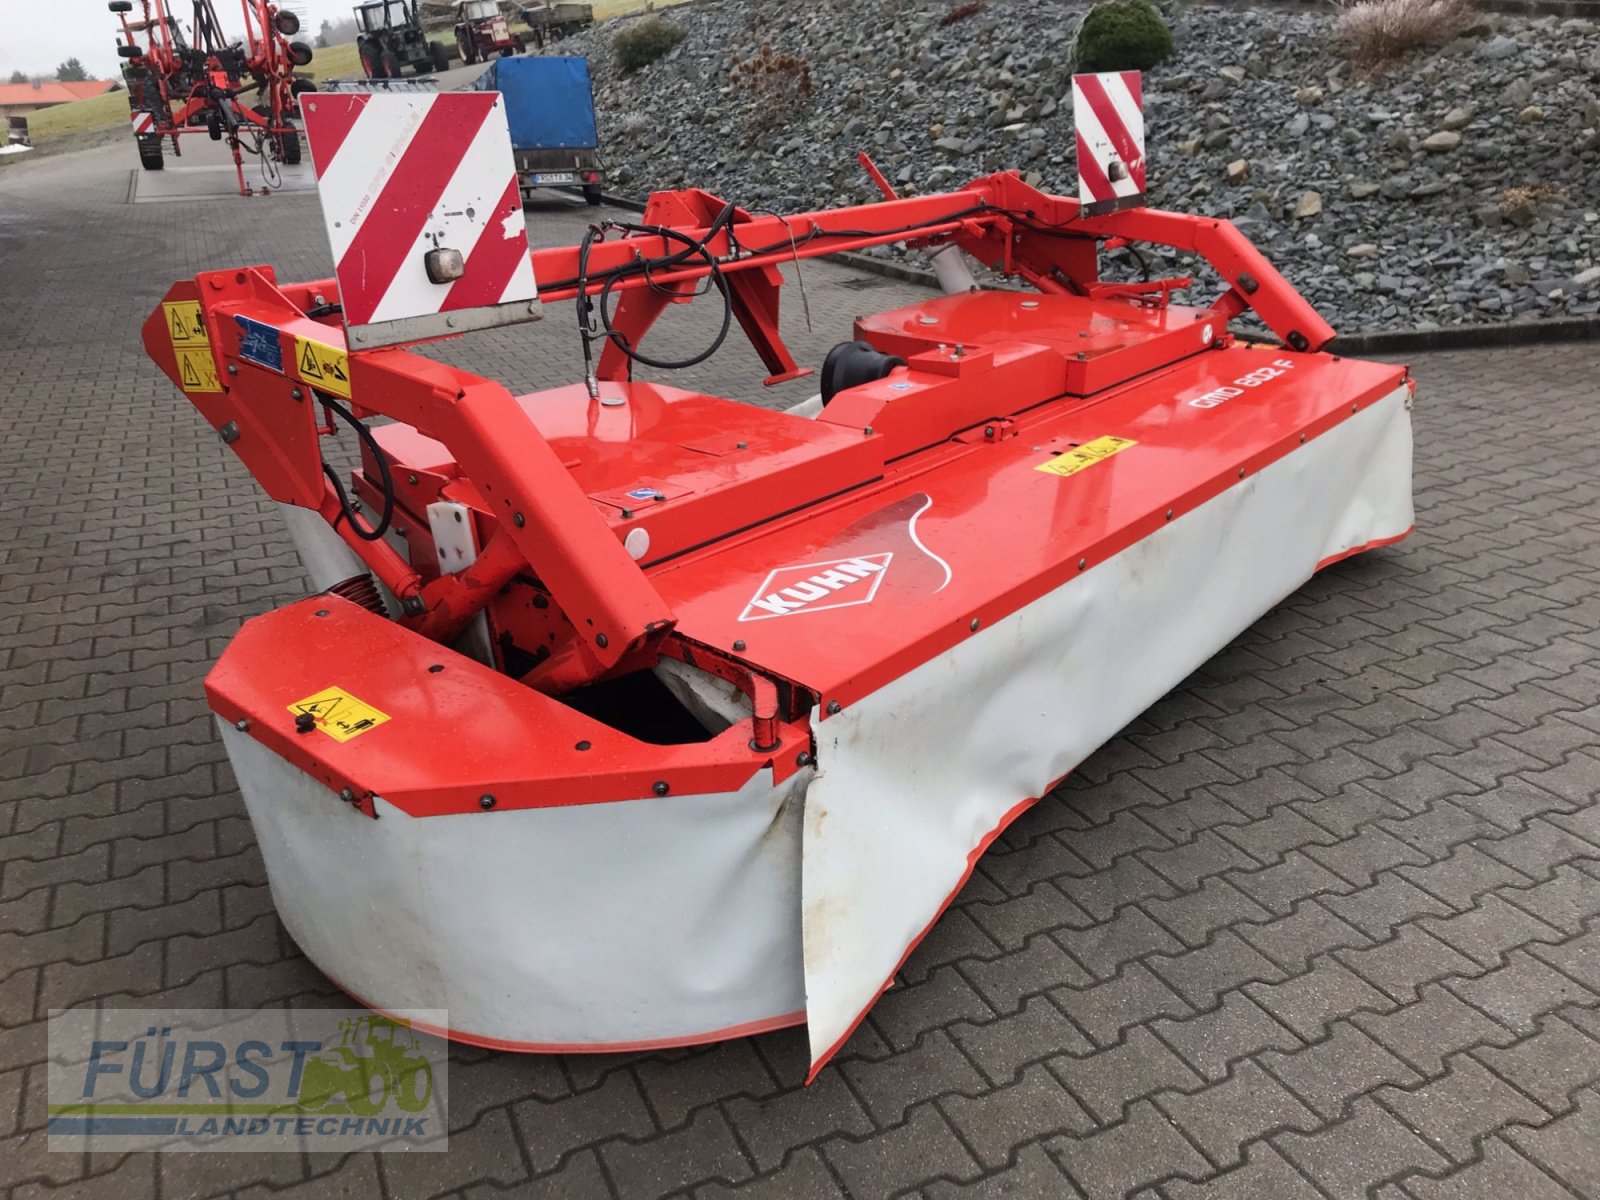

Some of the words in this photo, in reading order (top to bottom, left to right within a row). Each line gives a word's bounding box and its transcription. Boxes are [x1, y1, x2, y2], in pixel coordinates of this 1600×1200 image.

[350, 211, 361, 225] DIN
[1188, 386, 1245, 409] GMD
[1233, 367, 1286, 387] 802
[1272, 359, 1295, 369] F
[751, 558, 886, 615] KUHN
